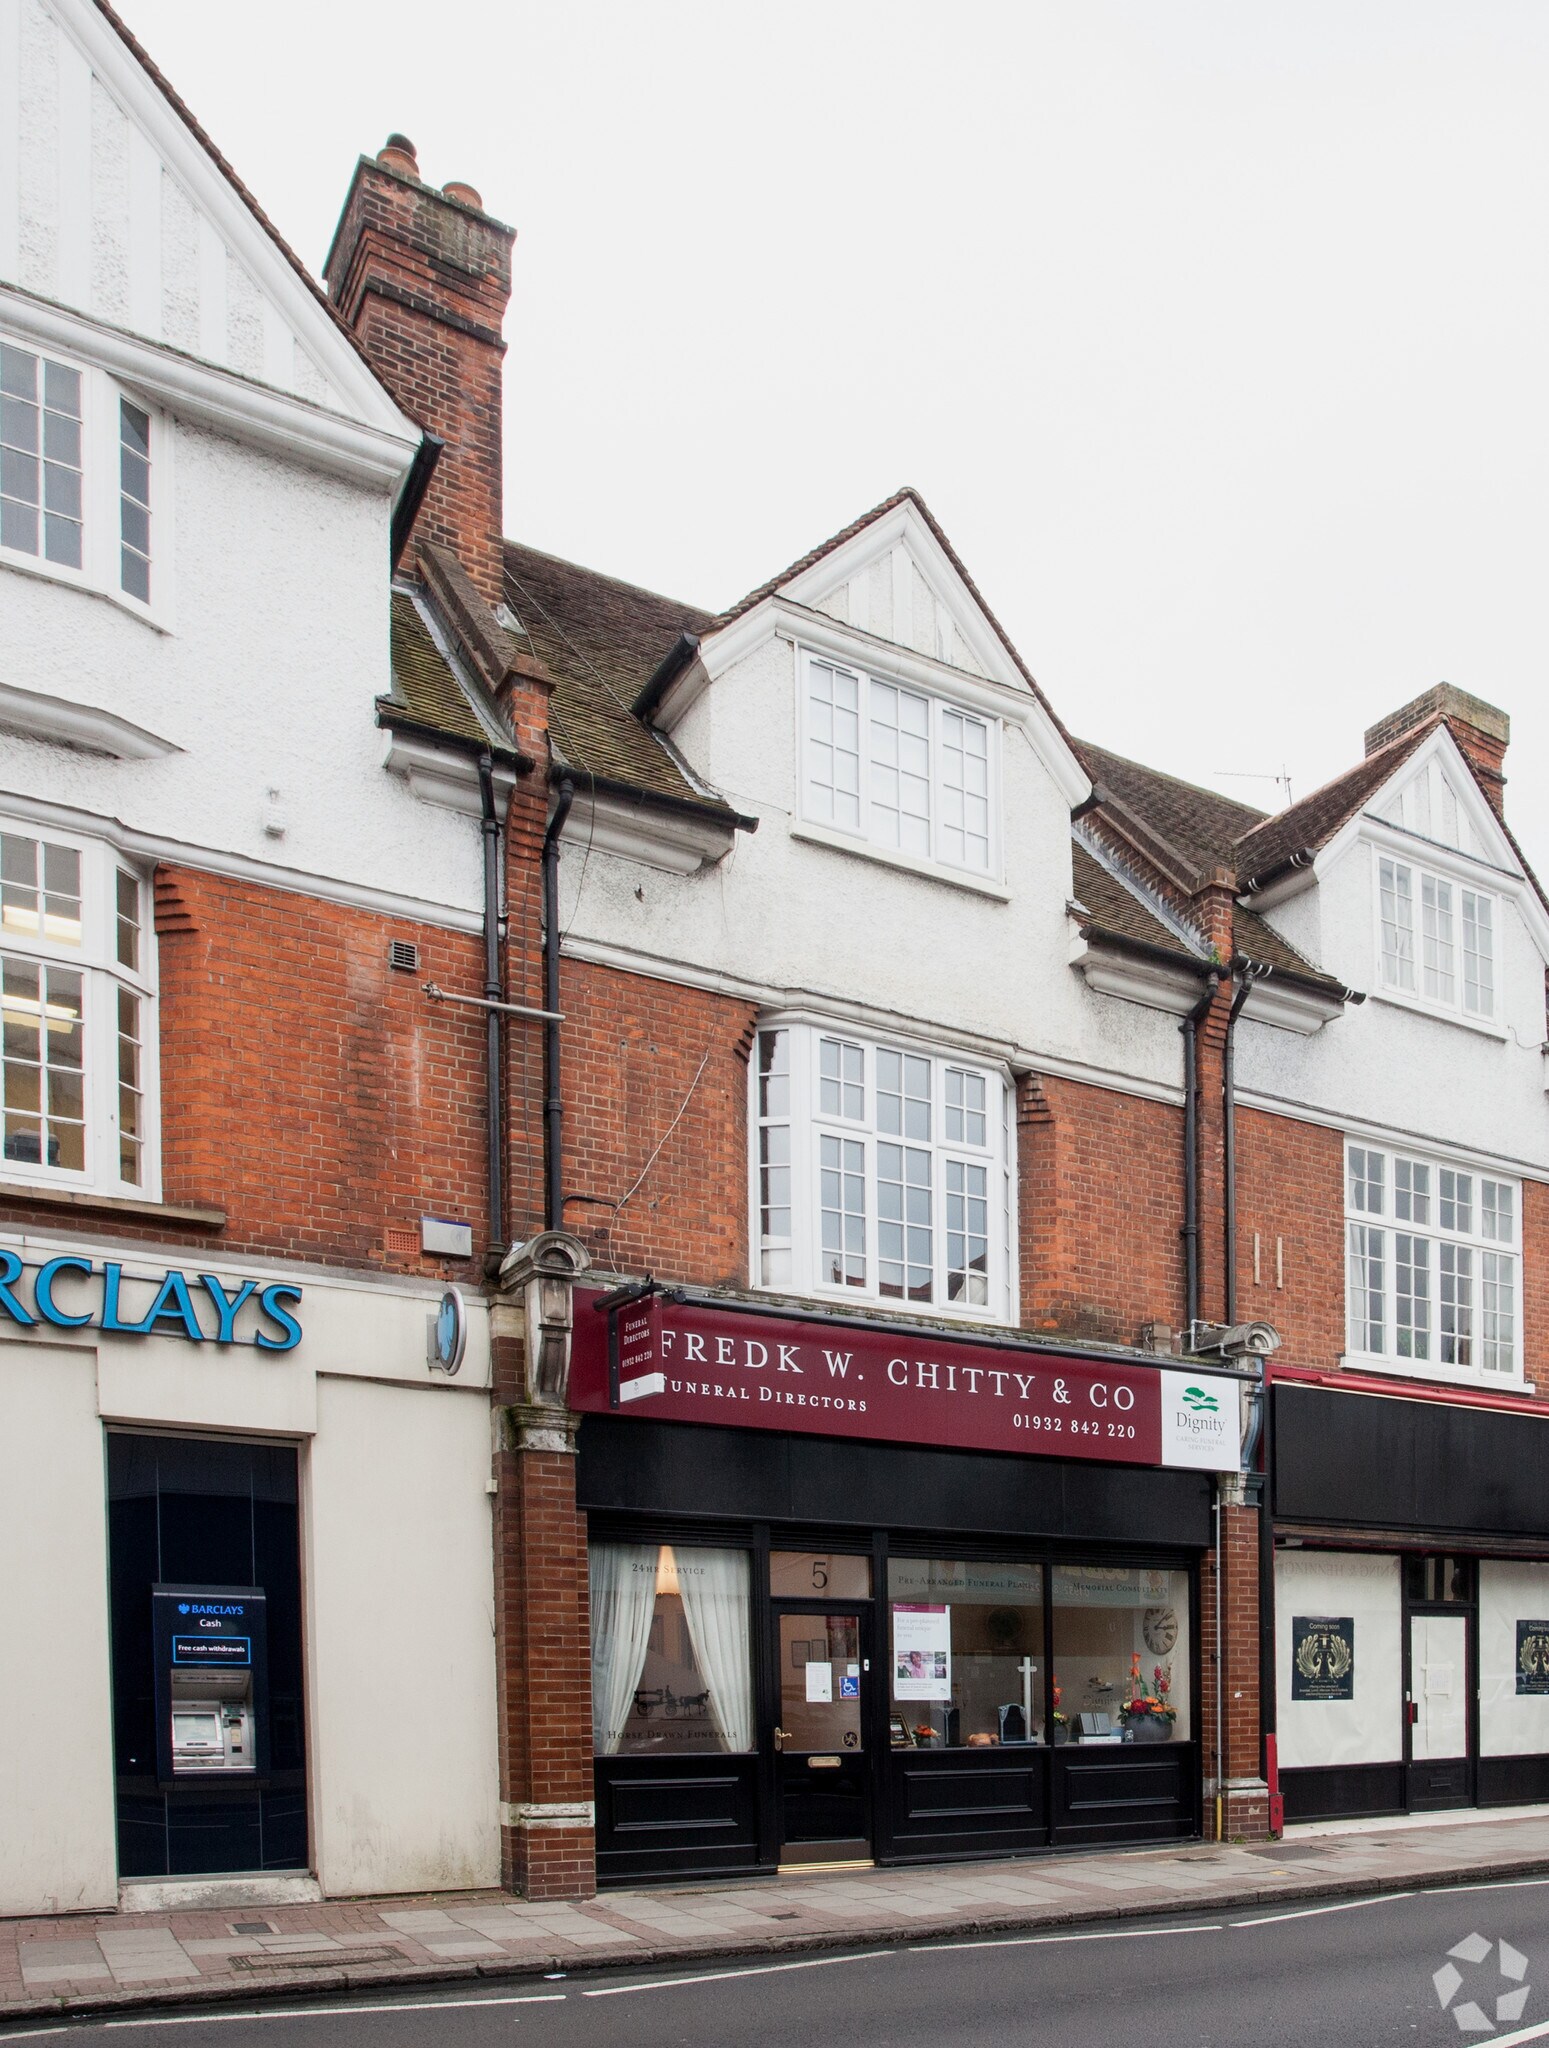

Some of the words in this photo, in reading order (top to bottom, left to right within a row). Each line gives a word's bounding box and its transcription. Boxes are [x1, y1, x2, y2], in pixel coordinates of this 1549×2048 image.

[625, 1317, 647, 1332] FUNERAL
[623, 1329, 650, 1345] DIRECTORS
[622, 1356, 634, 1368] 01932
[635, 1353, 643, 1363] 842
[644, 1350, 653, 1360] 220
[661, 1329, 804, 1374] FREDK
[821, 1350, 864, 1381] W.
[887, 1358, 1035, 1400] CHITTY
[1052, 1378, 1071, 1405] &
[1089, 1383, 1135, 1411] CO
[663, 1375, 750, 1400] UNERAL
[759, 1386, 867, 1413] DIRECTORS
[1013, 1413, 1062, 1432] 01932
[1071, 1419, 1100, 1436] 842
[1107, 1423, 1136, 1439] 220
[1176, 1412, 1226, 1436] Dignity
[1188, 1444, 1214, 1452] SERVICES
[632, 1564, 659, 1574] 24HR
[664, 1566, 706, 1575] SERVICE
[812, 1562, 828, 1589] 5
[968, 1579, 1004, 1588] FUNERAL
[1073, 1583, 1114, 1592] MEMORIAL
[191, 1604, 244, 1615] BARCLAYS
[199, 1619, 222, 1627] Cash
[608, 1731, 642, 1739] HORSE
[688, 1731, 737, 1739] FUNERALS
